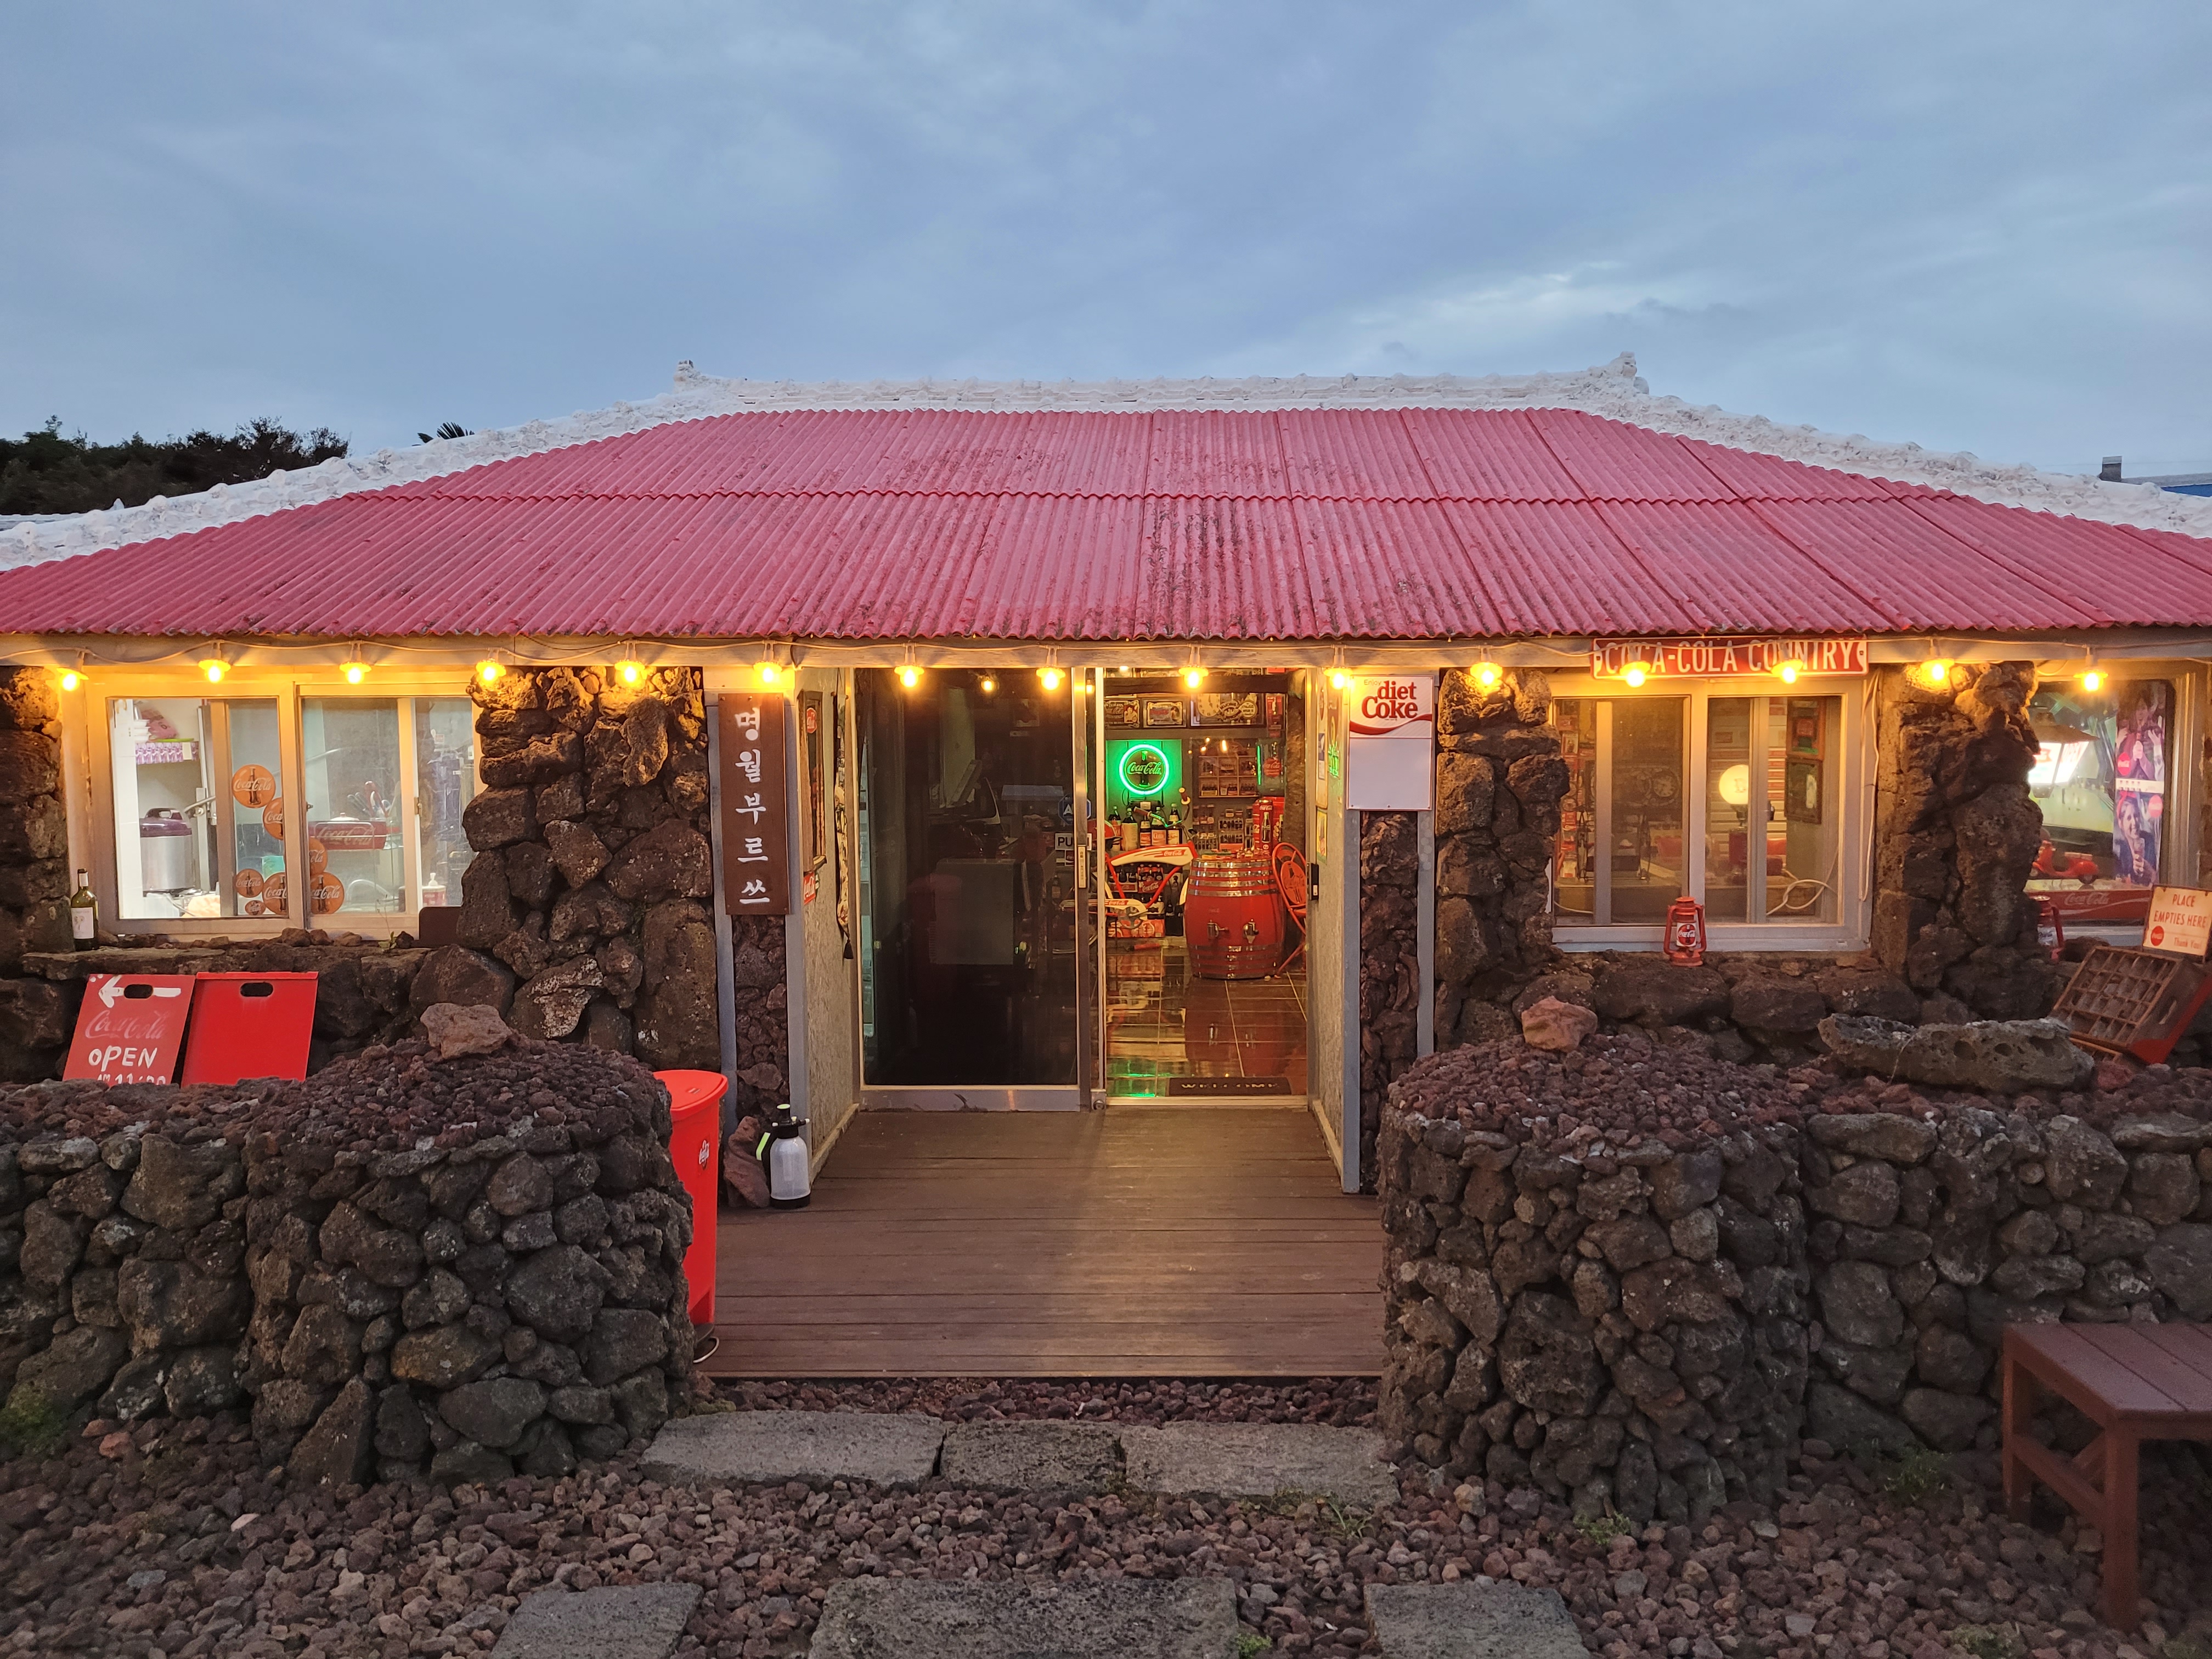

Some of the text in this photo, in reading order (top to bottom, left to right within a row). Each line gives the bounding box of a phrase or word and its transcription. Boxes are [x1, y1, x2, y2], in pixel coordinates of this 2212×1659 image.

[1378, 680, 1417, 699] diet
[1362, 695, 1418, 719] Coke
[1127, 761, 1162, 775] Coca-Cola
[233, 777, 273, 792] Coca-Cola
[235, 878, 261, 887] Coca-Cola
[2064, 893, 2111, 906] Coca-Cola
[2172, 894, 2196, 907] PLACE
[2153, 910, 2207, 929] EMPTIES HERE
[88, 1045, 157, 1072] OPEN
